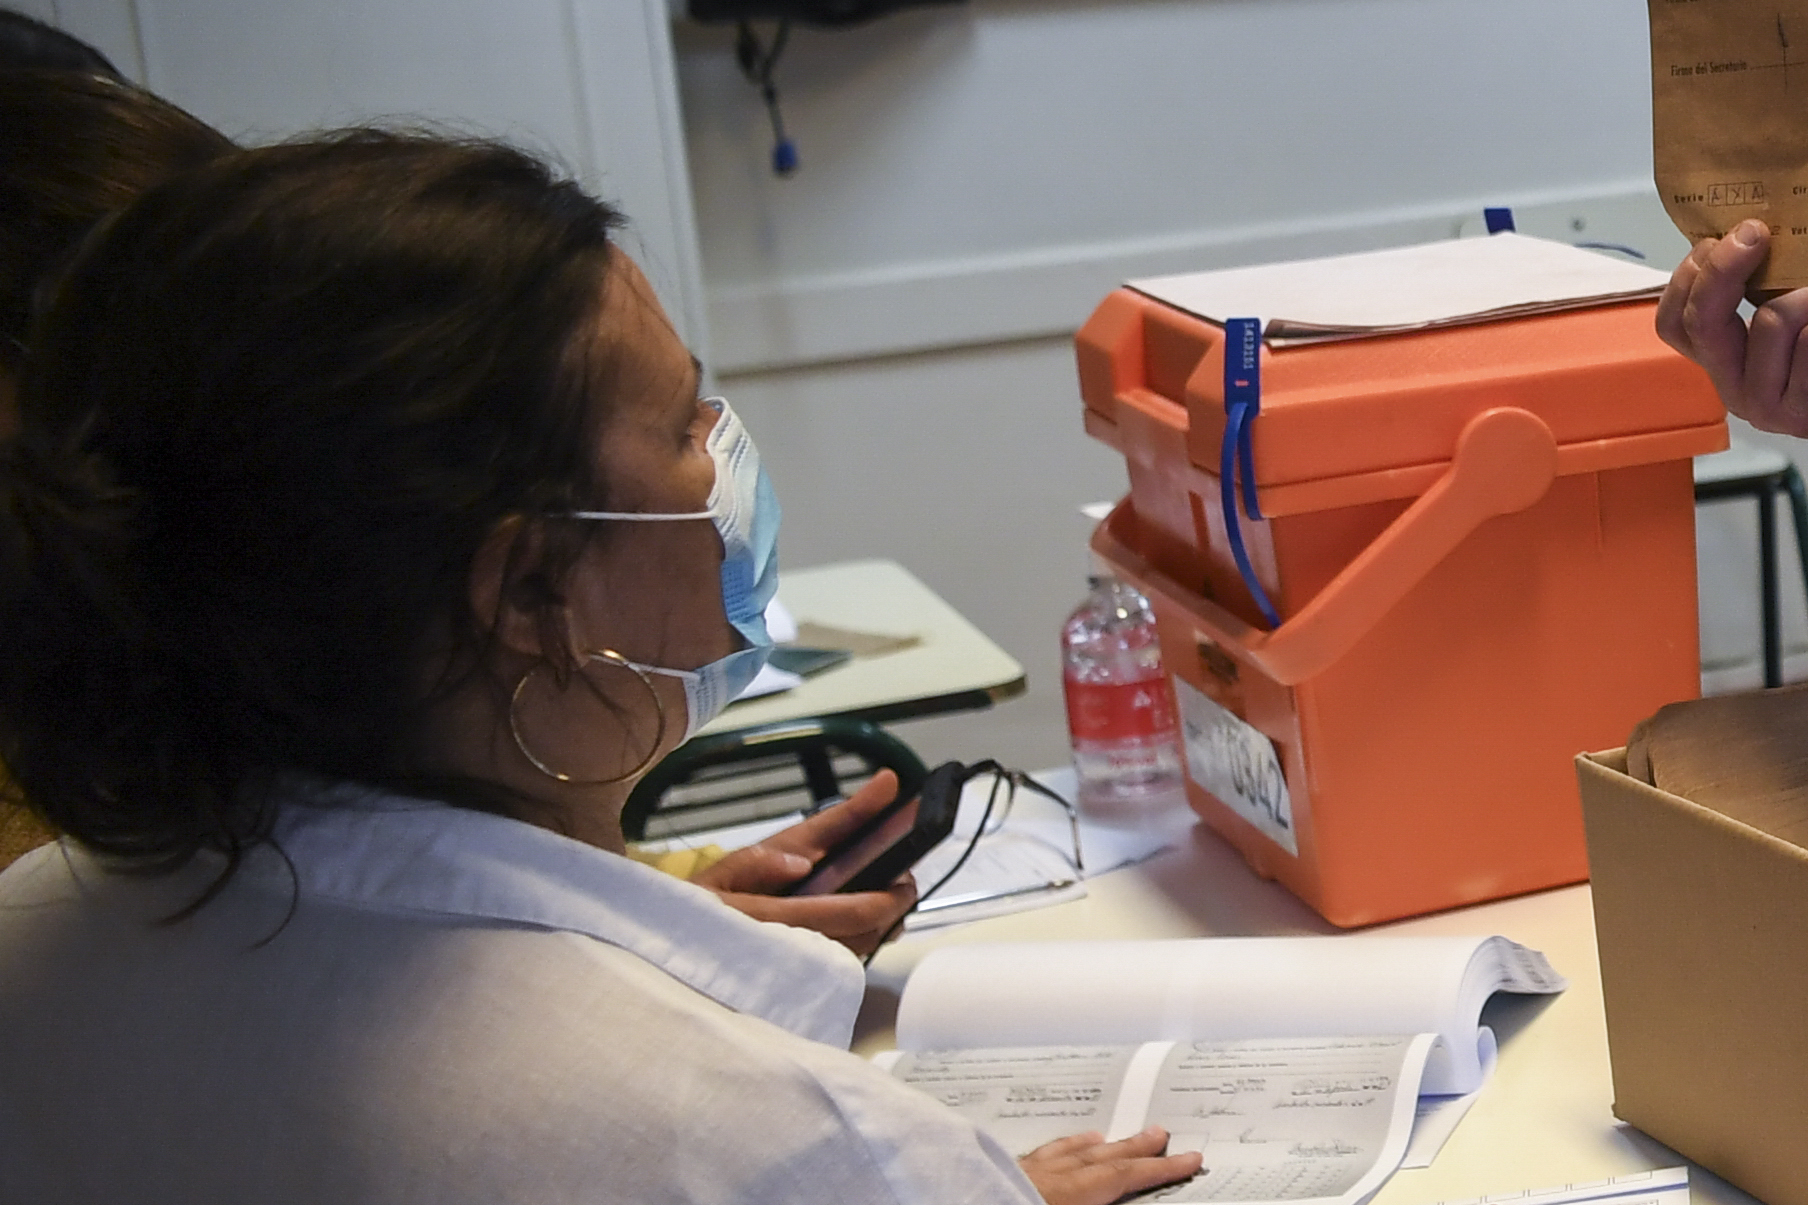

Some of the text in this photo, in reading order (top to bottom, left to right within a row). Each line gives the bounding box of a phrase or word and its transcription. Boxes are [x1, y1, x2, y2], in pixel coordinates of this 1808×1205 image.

[1671, 59, 1748, 77] Firma del Secretario
[1674, 194, 1704, 205] Serie
